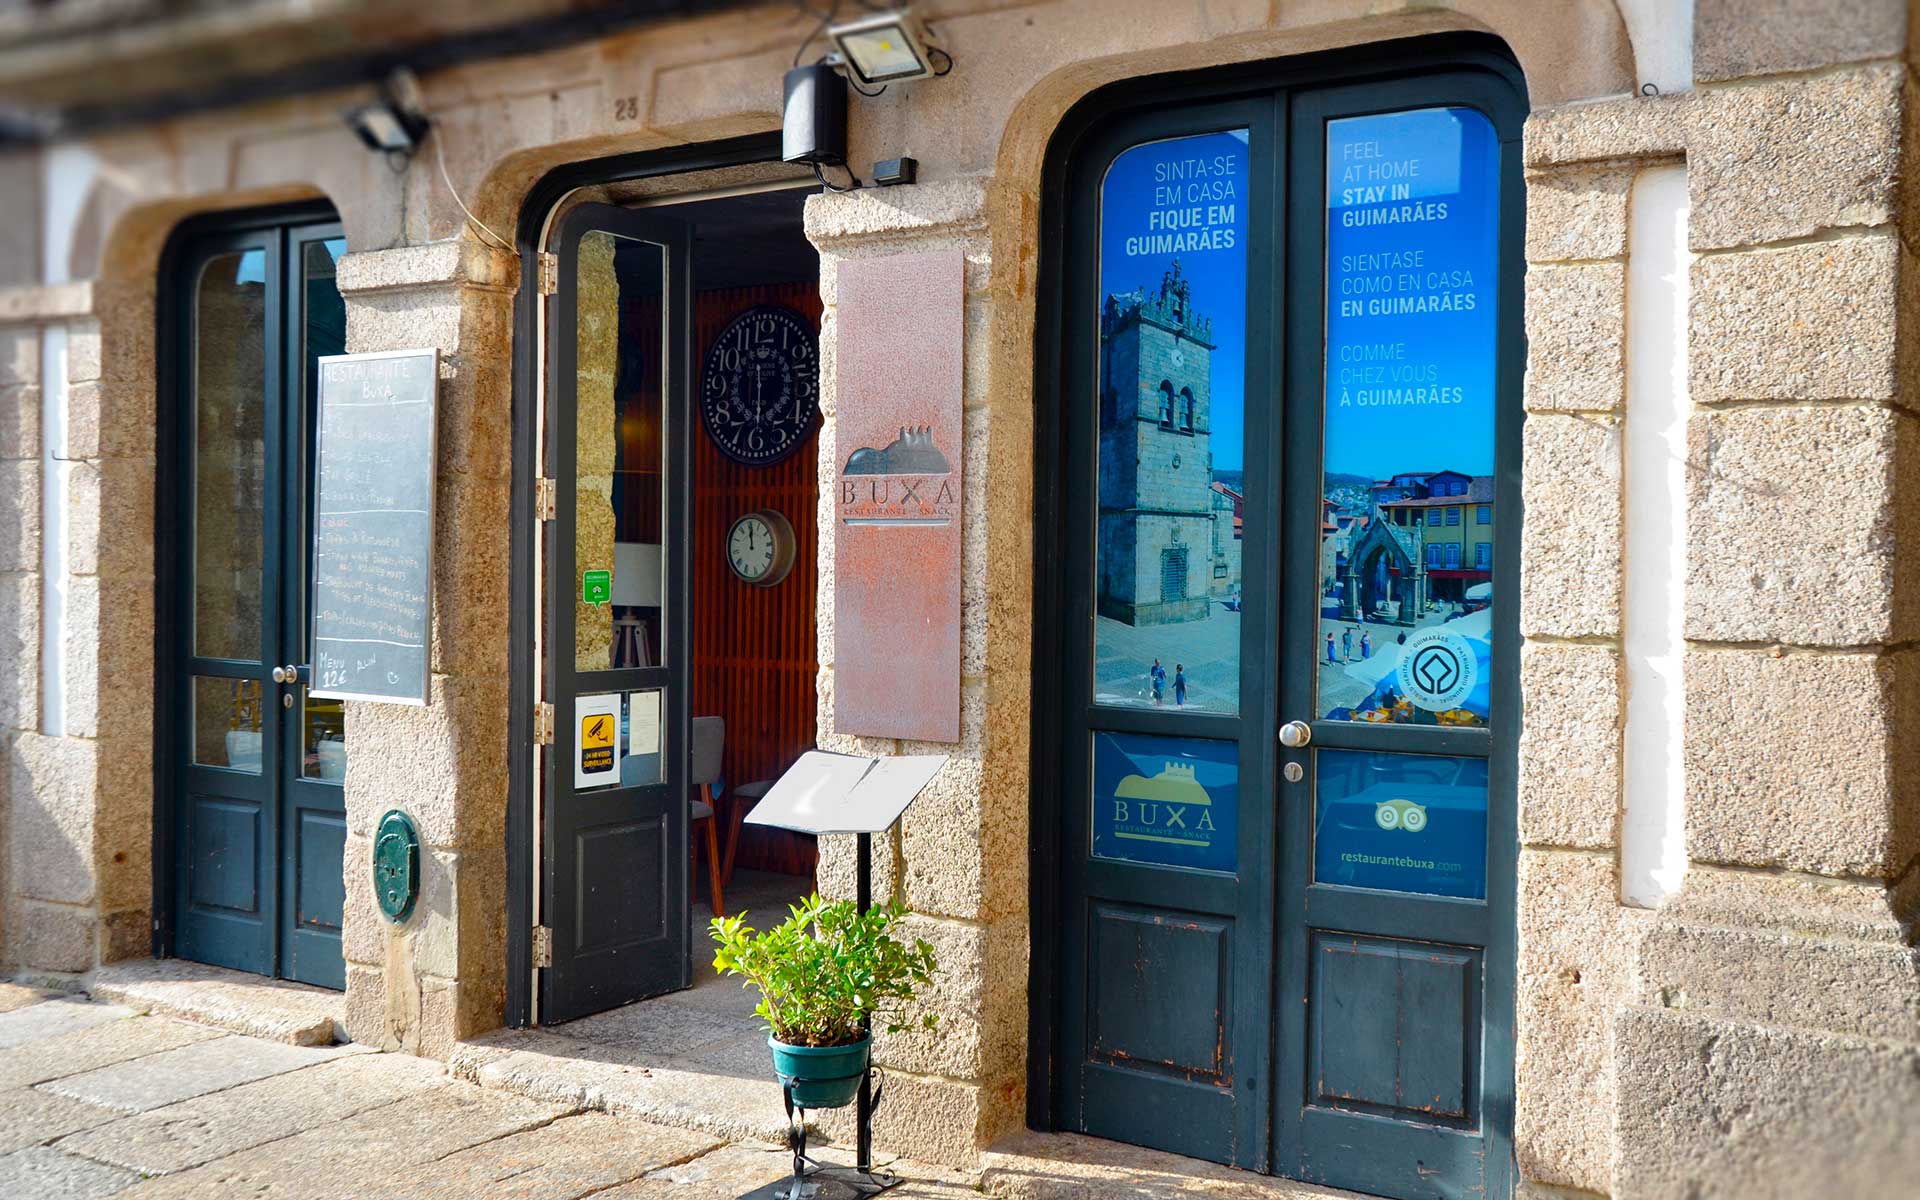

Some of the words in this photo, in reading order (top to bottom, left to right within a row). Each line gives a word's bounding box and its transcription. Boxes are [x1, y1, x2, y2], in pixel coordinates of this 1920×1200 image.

[614, 96, 638, 121] 23
[1343, 141, 1384, 161] FEEL
[1154, 155, 1236, 182] SINTA-SE
[1343, 165, 1363, 183] AT
[1368, 159, 1420, 181] HOME
[1155, 185, 1181, 206] EM
[1187, 180, 1236, 203] CASA
[1343, 185, 1386, 206] STAY
[1391, 183, 1410, 201] IN
[1150, 207, 1202, 231] FIQUE
[1208, 204, 1235, 226] EM
[1342, 201, 1448, 228] GUIMARÃES
[1126, 226, 1235, 256] GUIMARÃES
[1342, 250, 1424, 273] SIENTASE
[1342, 275, 1393, 295] COMO
[1398, 274, 1420, 292] EN
[1427, 270, 1474, 290] CASA
[1341, 300, 1363, 318] EN
[1369, 291, 1476, 316] GUIMARÃES
[737, 327, 750, 351] 11
[755, 319, 776, 343] 12
[720, 347, 740, 371] 10
[792, 345, 807, 369] 2
[1340, 343, 1406, 362] COMME
[711, 375, 727, 398] 9
[797, 373, 812, 397] 3
[1340, 366, 1384, 385] CHEZ
[1391, 364, 1438, 383] VOUS
[1340, 387, 1351, 408] À
[1357, 384, 1463, 407] GUIMARÃES
[715, 400, 730, 424] 8
[786, 400, 803, 424] 4
[731, 421, 746, 445] 7
[748, 427, 764, 451] 6
[770, 420, 787, 444] 5
[841, 480, 953, 505] BUXA
[1413, 634, 1449, 649] GUIMARÃES
[323, 669, 347, 688] 12€
[1113, 800, 1217, 831] BUXA
[1114, 824, 1173, 836] RESTAURANTE
[1183, 831, 1211, 841] SNACK
[1341, 852, 1462, 873] restaurantebuxa.com
